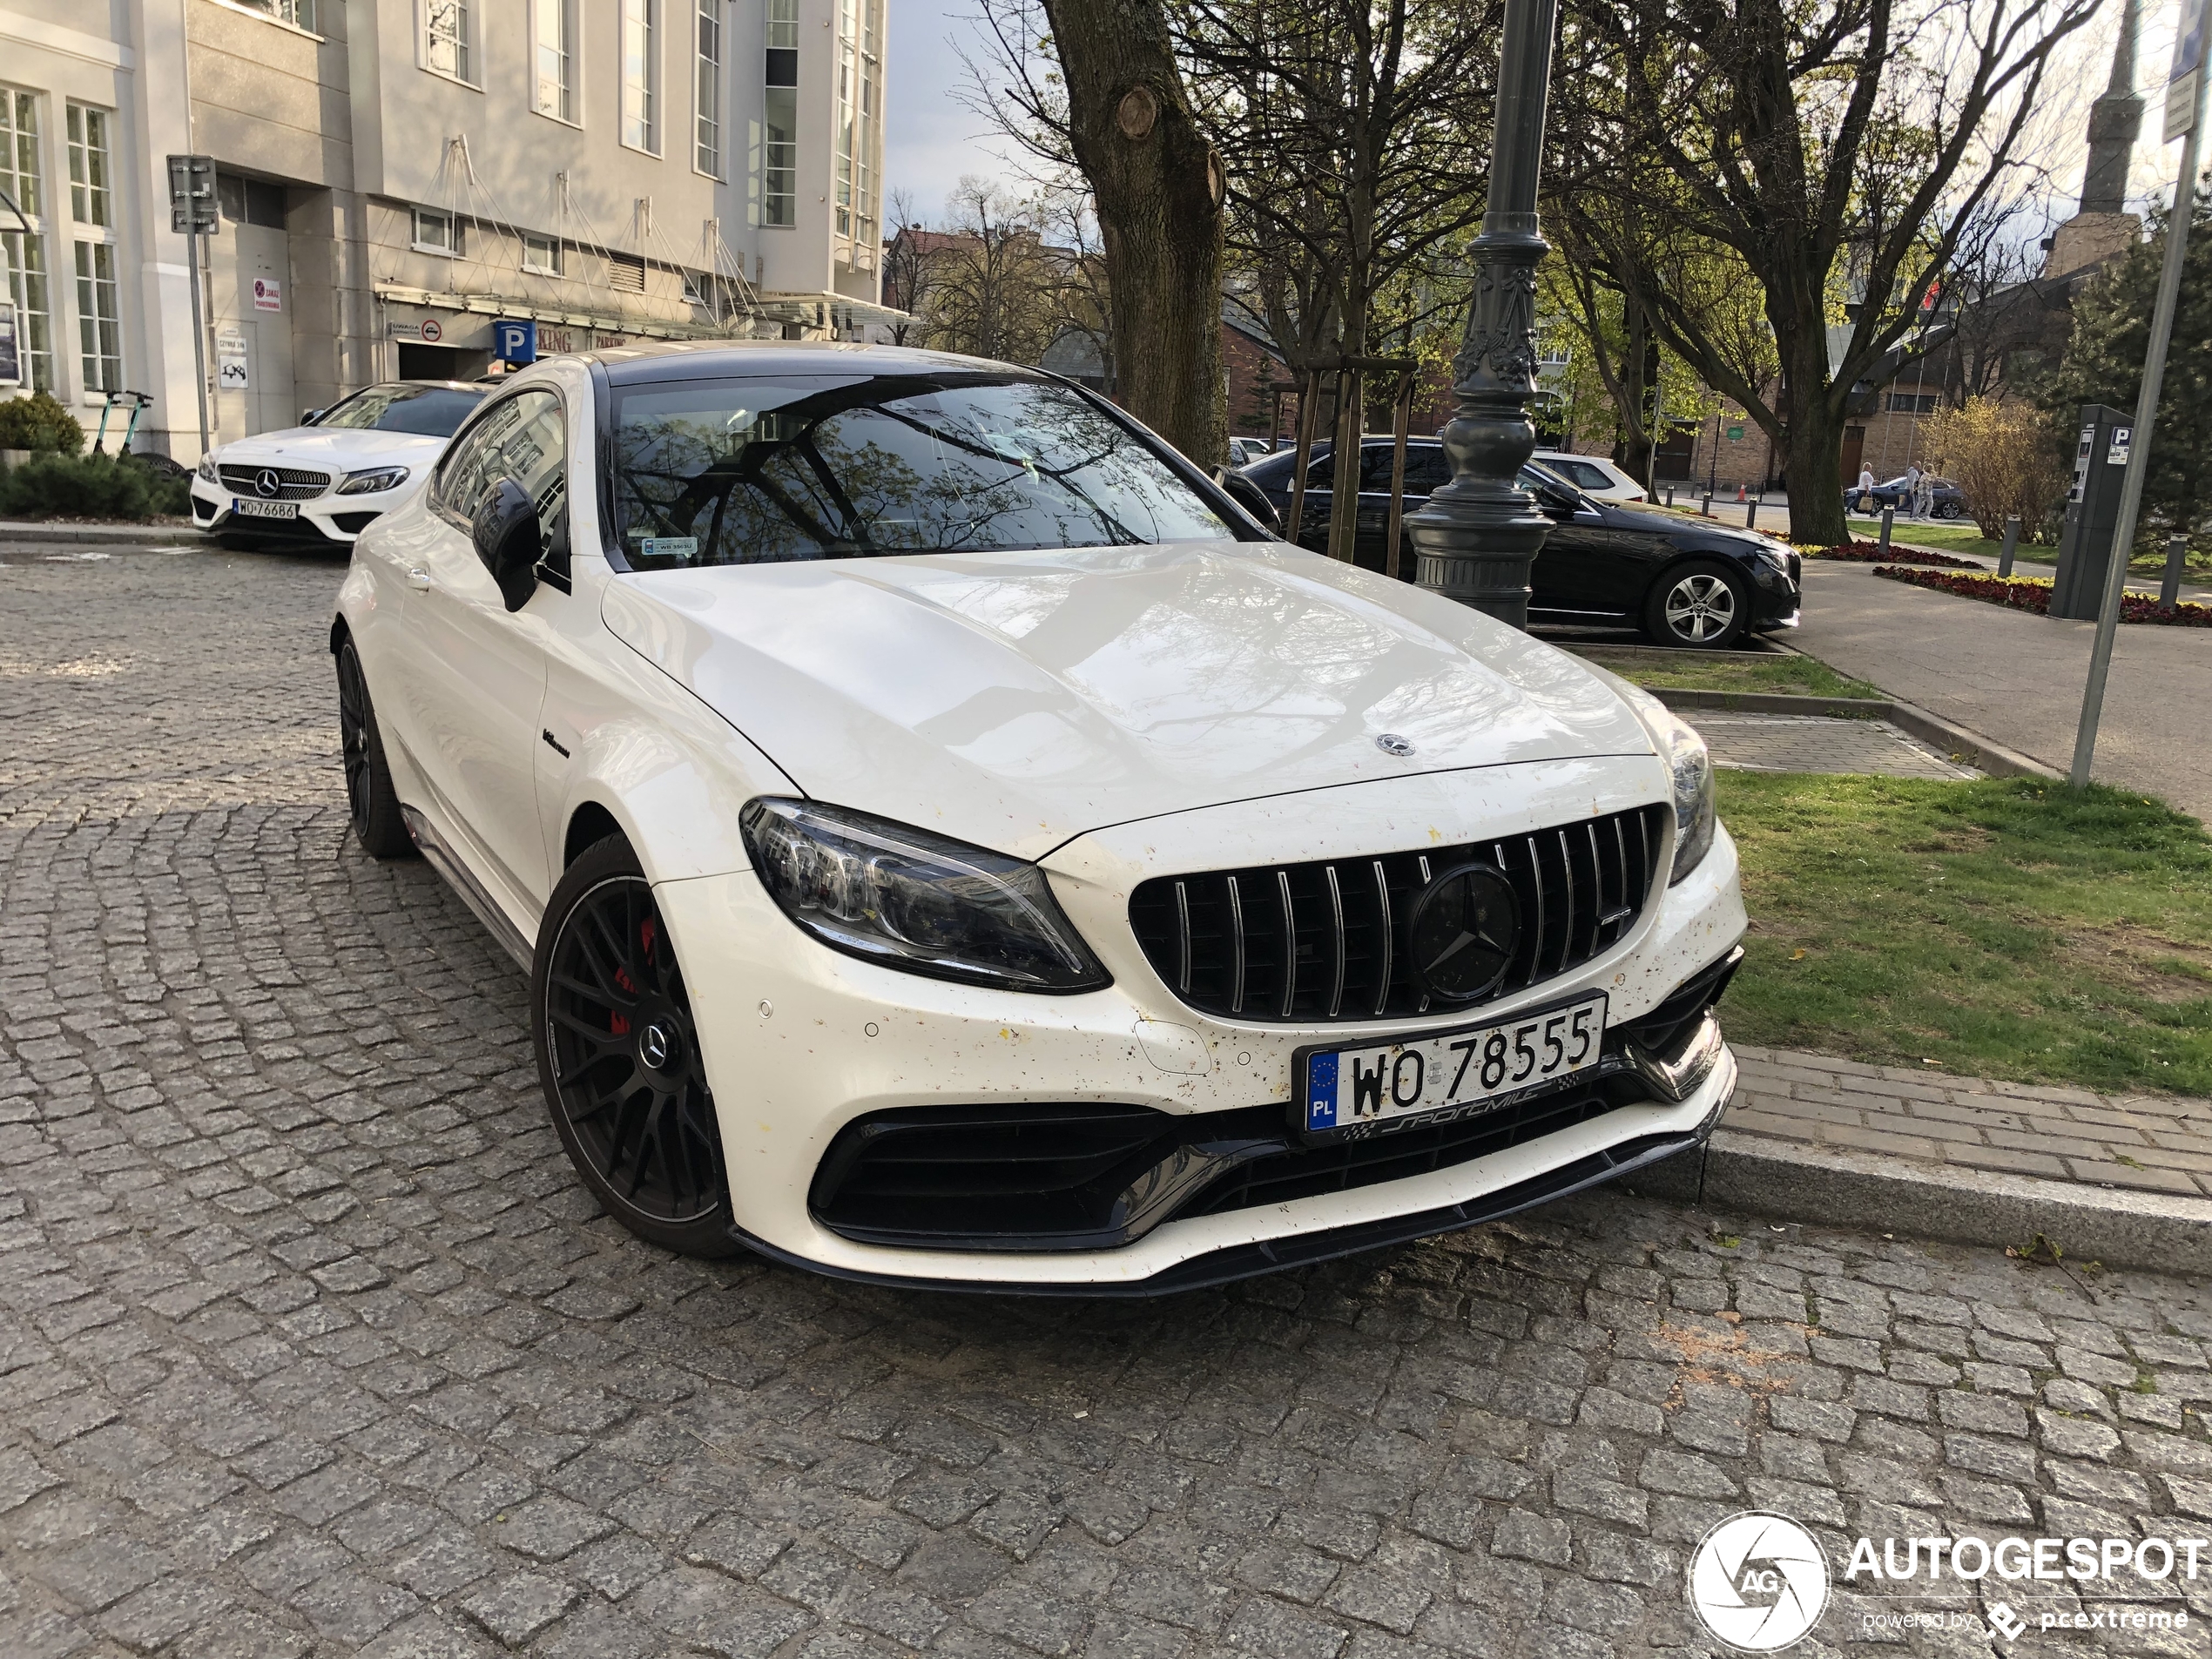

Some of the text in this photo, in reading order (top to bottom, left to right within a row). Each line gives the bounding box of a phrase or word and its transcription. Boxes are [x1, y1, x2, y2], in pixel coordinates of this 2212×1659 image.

[505, 329, 525, 356] P
[536, 328, 571, 353] KING
[596, 335, 626, 348] PARKING
[2114, 428, 2130, 444] P
[239, 502, 253, 515] WO
[258, 502, 293, 517] 76686
[1352, 1007, 1593, 1116] WO 78555
[1312, 1100, 1333, 1117] PL
